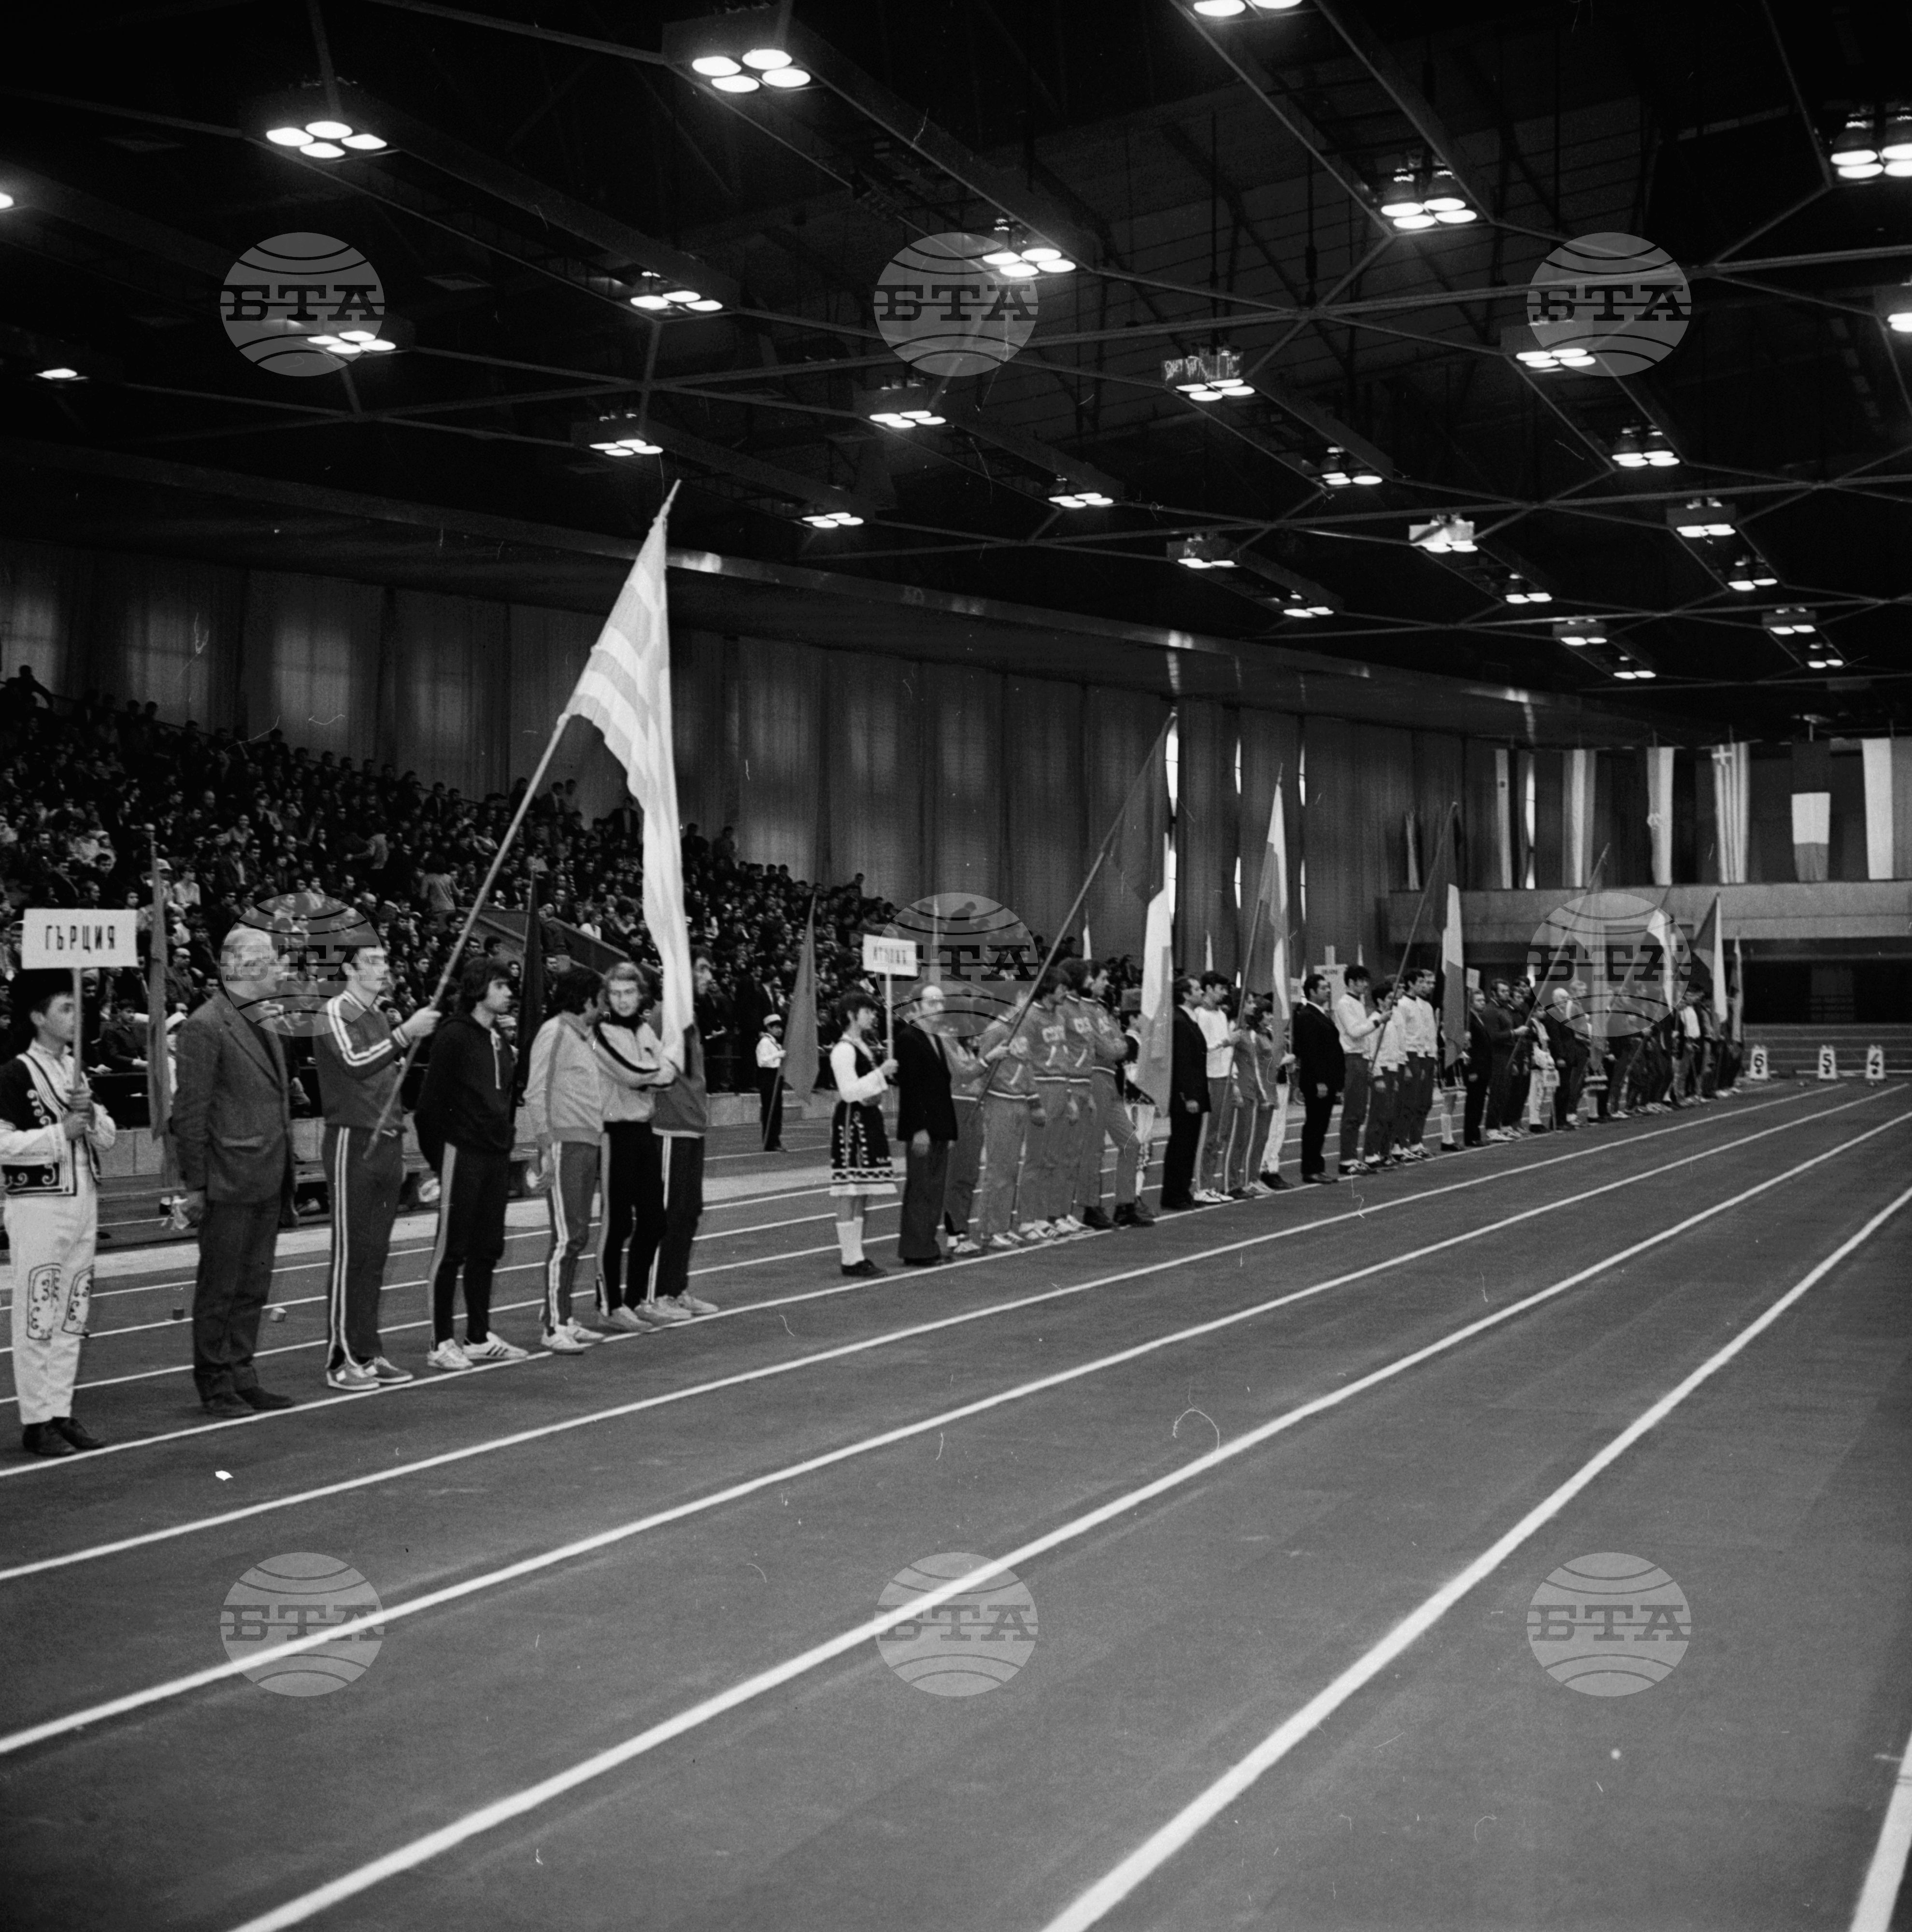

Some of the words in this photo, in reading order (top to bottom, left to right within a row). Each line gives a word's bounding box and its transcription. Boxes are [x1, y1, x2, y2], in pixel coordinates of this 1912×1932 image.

[46, 925, 115, 953] ГЪРЦИЯ
[1754, 1053, 1764, 1068] 6
[1822, 1053, 1832, 1068] 5
